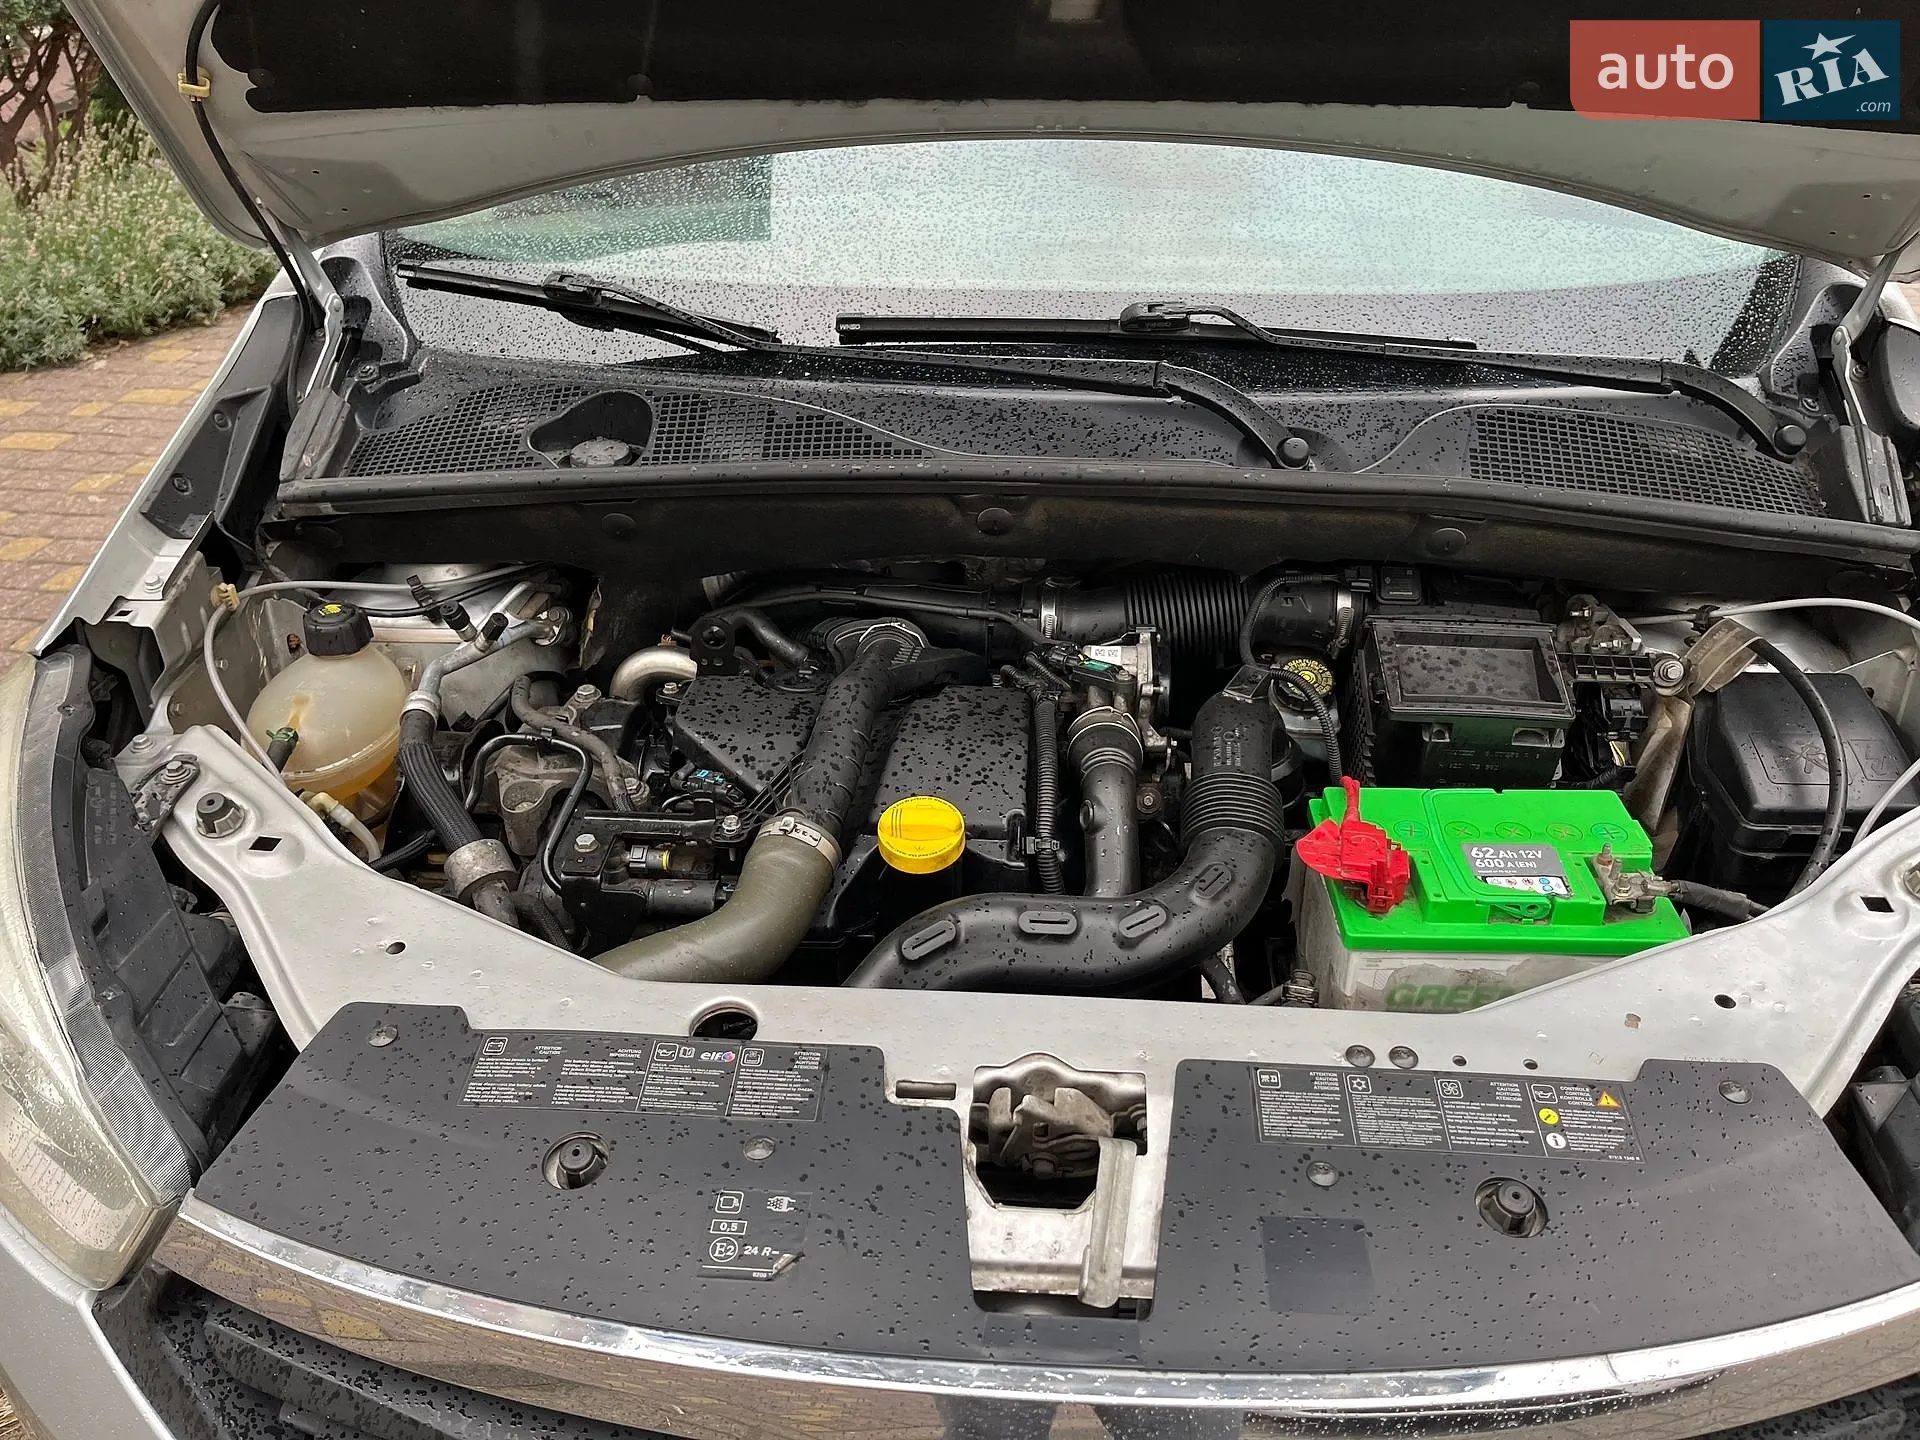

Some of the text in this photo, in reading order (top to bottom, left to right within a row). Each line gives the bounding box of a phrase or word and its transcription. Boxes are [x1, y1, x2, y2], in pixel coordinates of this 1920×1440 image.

[1471, 847, 1542, 859] 62 Ah 12V
[1475, 858, 1505, 868] 600
[700, 1050, 723, 1061] elf
[719, 1222, 738, 1232] 0,5
[713, 1242, 735, 1257] E2
[743, 1245, 759, 1255] 24
